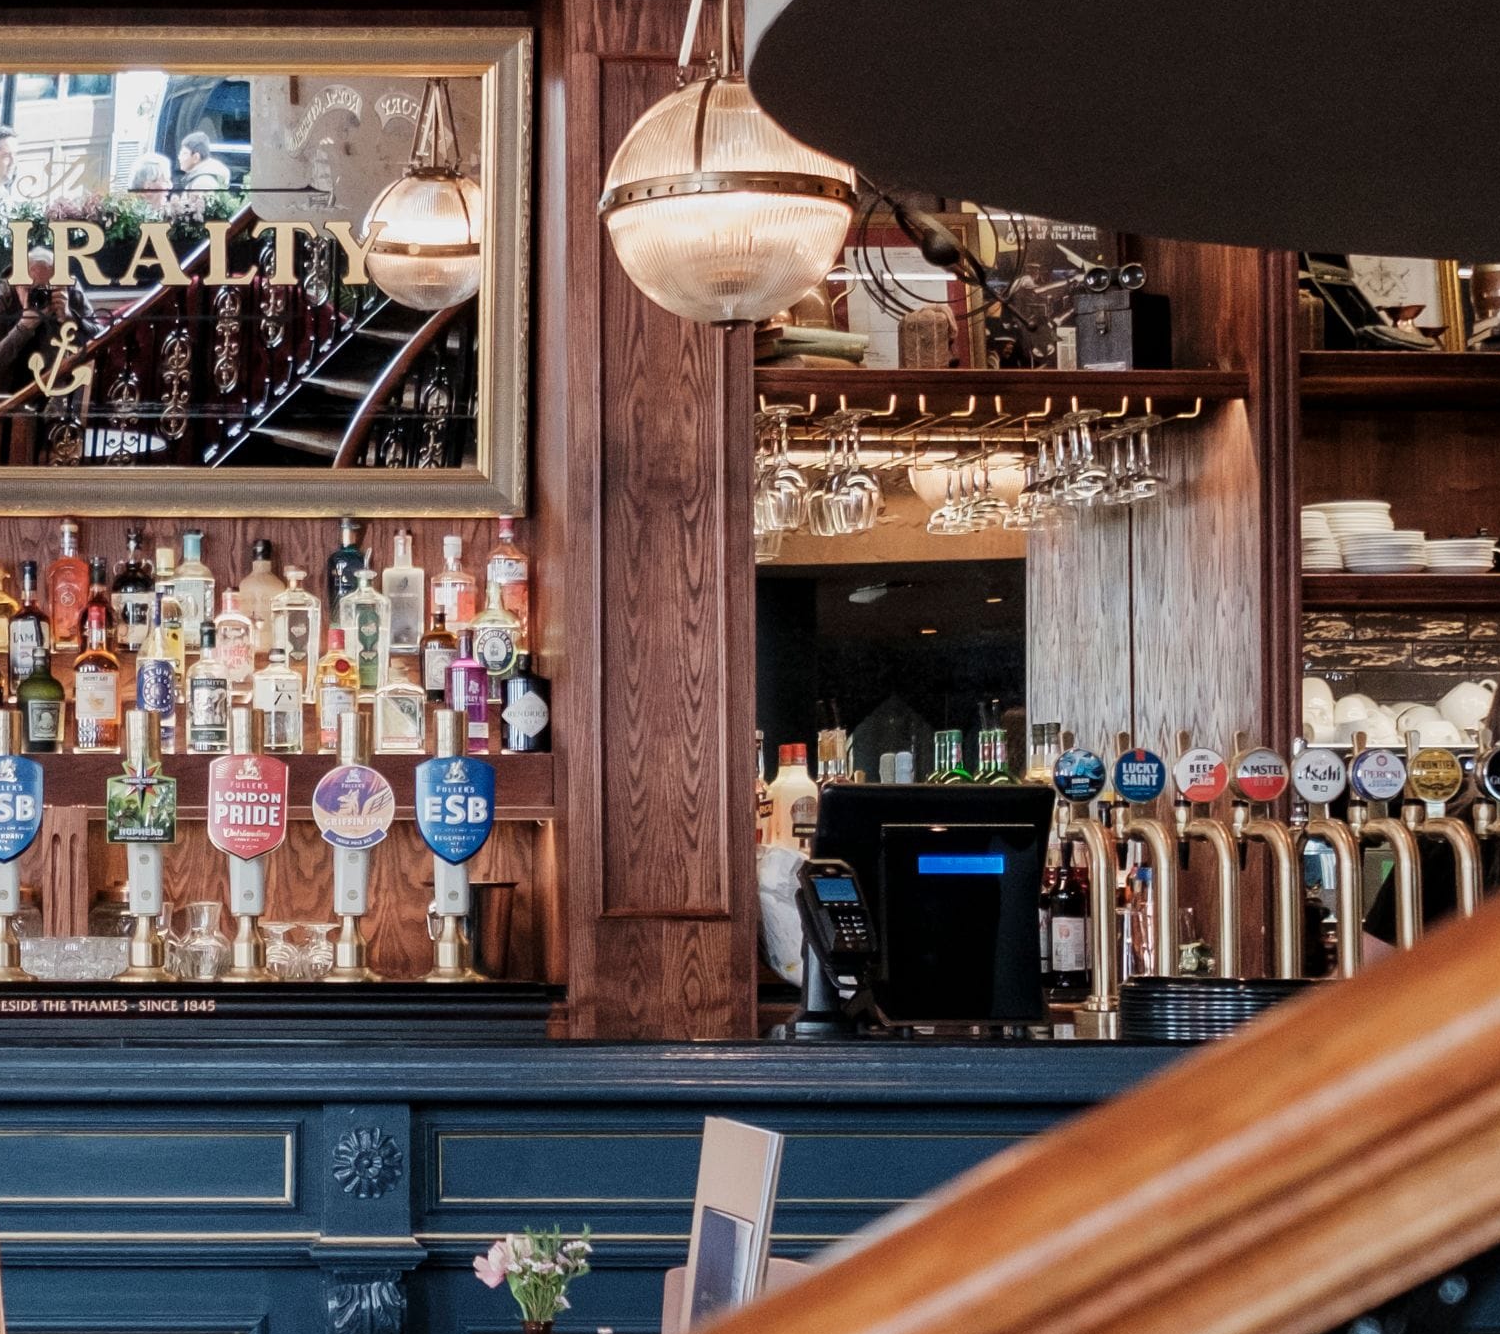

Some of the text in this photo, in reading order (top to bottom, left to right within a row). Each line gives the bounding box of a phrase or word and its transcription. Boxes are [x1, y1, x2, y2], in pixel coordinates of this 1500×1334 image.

[1080, 224, 1097, 232] the
[1051, 231, 1068, 240] the
[1071, 232, 1097, 240] Fleet
[1122, 762, 1159, 774] LUCKY
[1241, 765, 1284, 776] AMSTEL
[1298, 764, 1341, 782] Asahi
[1122, 774, 1158, 786] SAINT
[1253, 778, 1274, 787] BIER
[215, 791, 281, 803] LONDON
[424, 794, 488, 825] ESB
[214, 805, 281, 827] PRIDE
[324, 817, 383, 827] GRIFFIN IPA
[119, 827, 164, 836] HOPHEAD
[41, 999, 67, 1012] THE
[70, 999, 128, 1012] THAMES
[138, 999, 178, 1012] SINCE
[183, 999, 216, 1012] 1845
